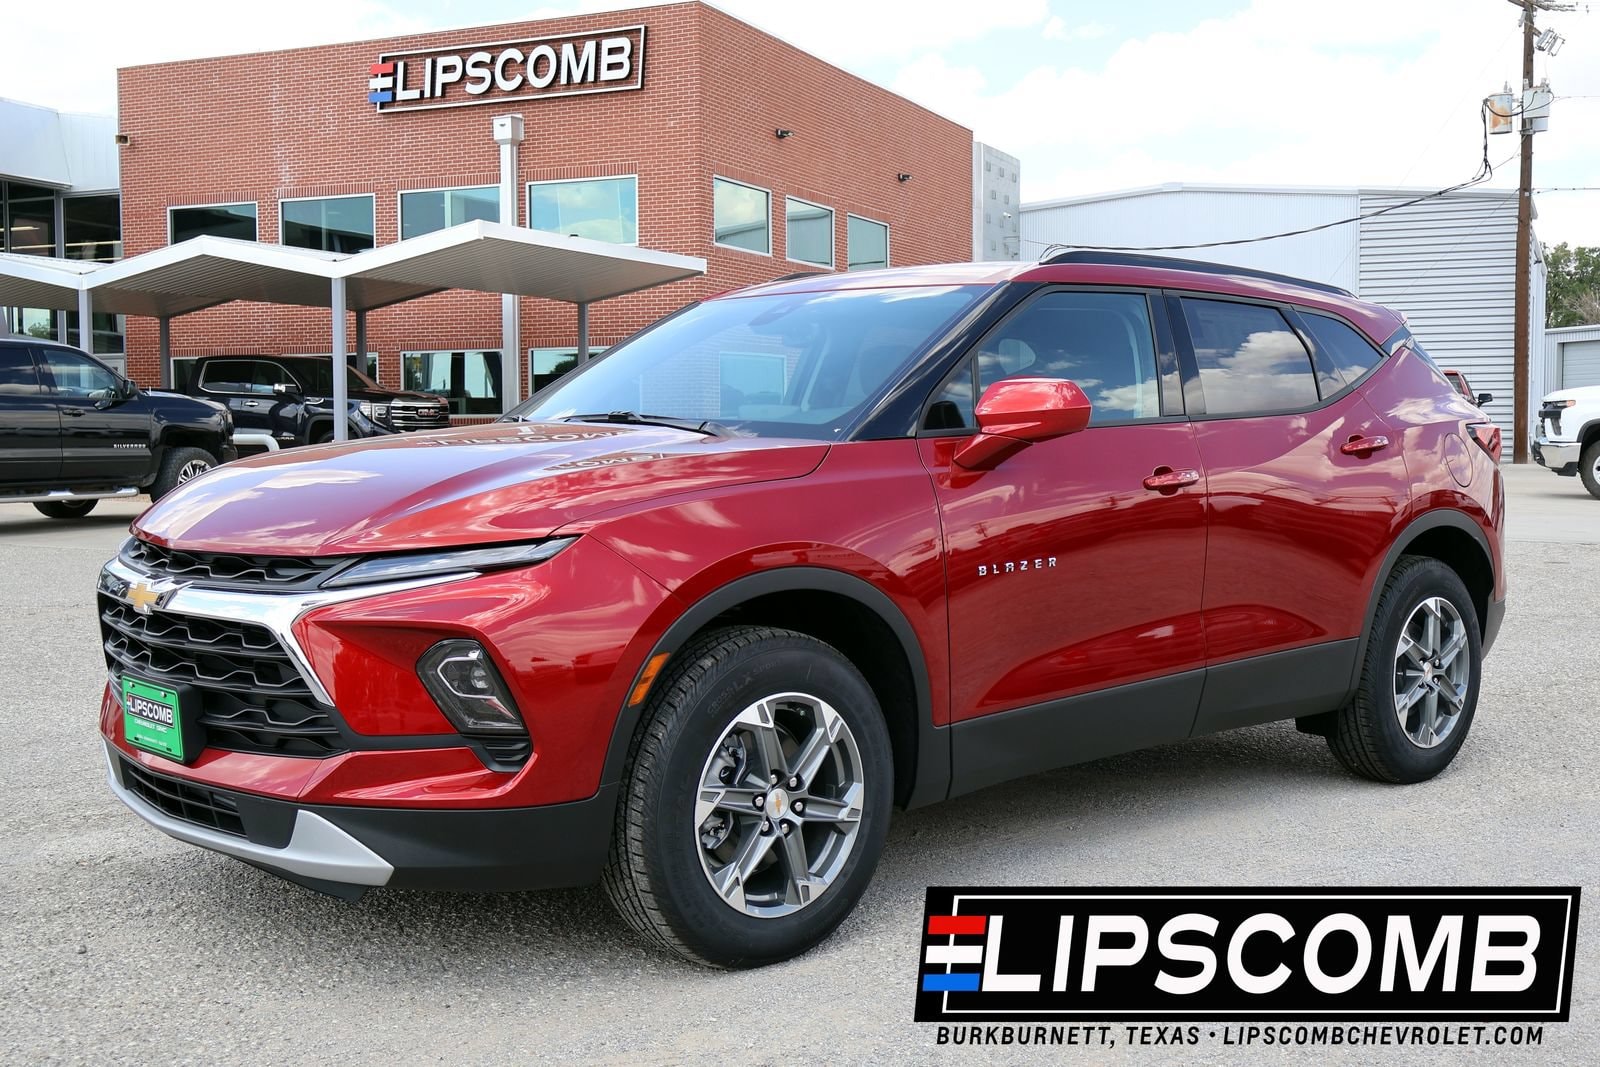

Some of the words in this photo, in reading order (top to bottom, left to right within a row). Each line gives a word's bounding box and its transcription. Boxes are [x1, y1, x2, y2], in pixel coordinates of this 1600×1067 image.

[396, 37, 633, 101] LIPSCOMB
[418, 408, 440, 417] GMC
[978, 557, 1057, 576] BLAZER
[129, 697, 173, 725] LIPSCOMB
